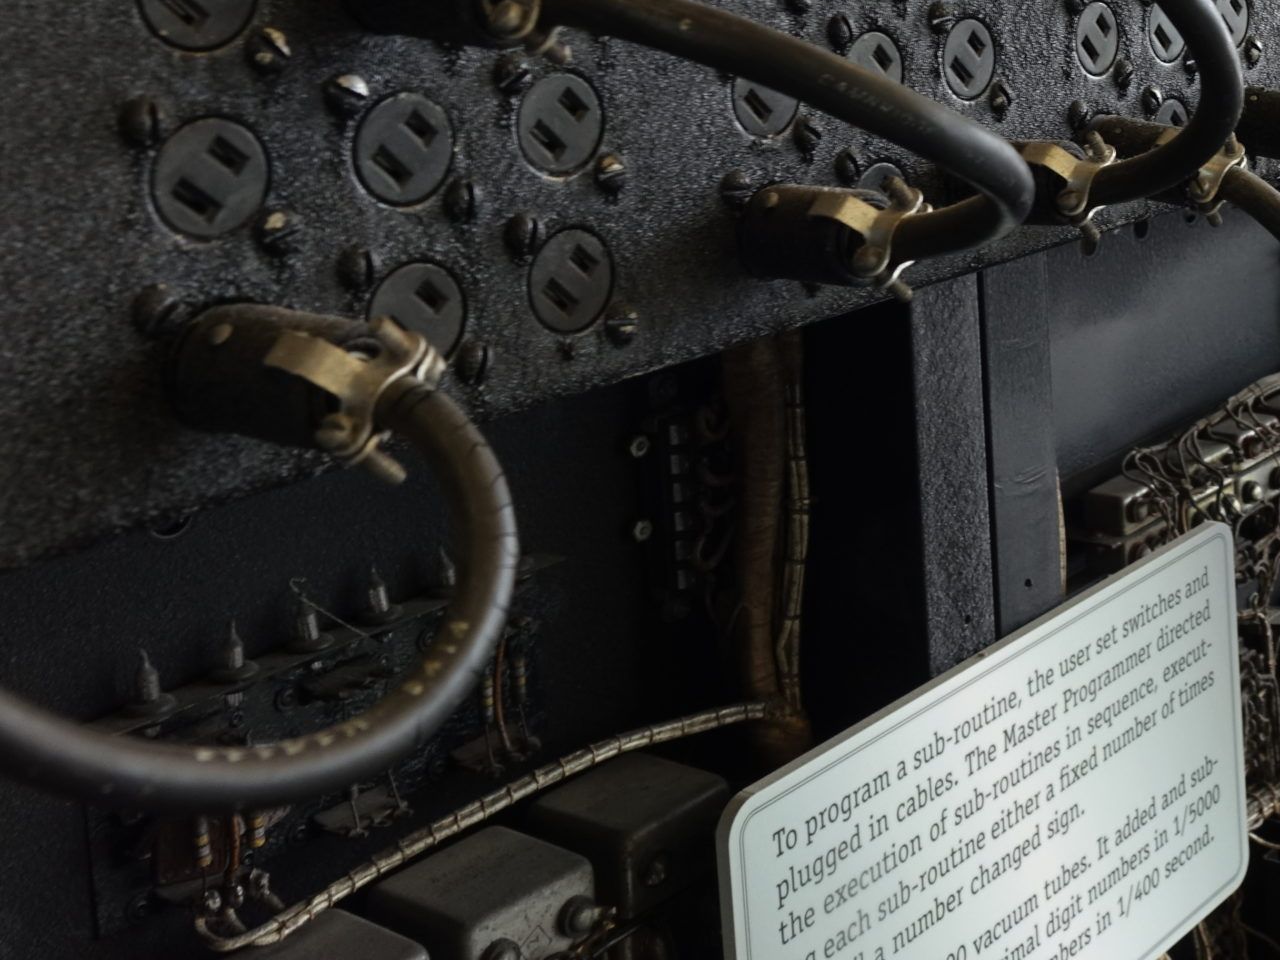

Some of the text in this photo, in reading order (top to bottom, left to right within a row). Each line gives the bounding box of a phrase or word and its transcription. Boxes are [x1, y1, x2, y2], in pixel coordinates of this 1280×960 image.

[772, 565, 1210, 858] To program a sub-routine, the user set switches and
[776, 598, 1211, 910] plugged in cables. The Master Programmer directed
[778, 638, 1212, 946] the execution of sub-routines in sequence, execut-
[823, 670, 1215, 958] each sub-routine either a fixed number of times
[892, 885, 964, 955] number
[970, 823, 1042, 896] changed
[1047, 801, 1085, 840] sign.
[973, 755, 1218, 955] vacuum tubes. It added and sub-
[1046, 893, 1083, 938] digit
[1087, 842, 1150, 905] numbers
[1154, 828, 1169, 853] in
[1174, 783, 1220, 837] 1/5000
[1096, 910, 1112, 936] in
[1117, 867, 1160, 918] 1/400
[1164, 823, 1215, 880] second.
